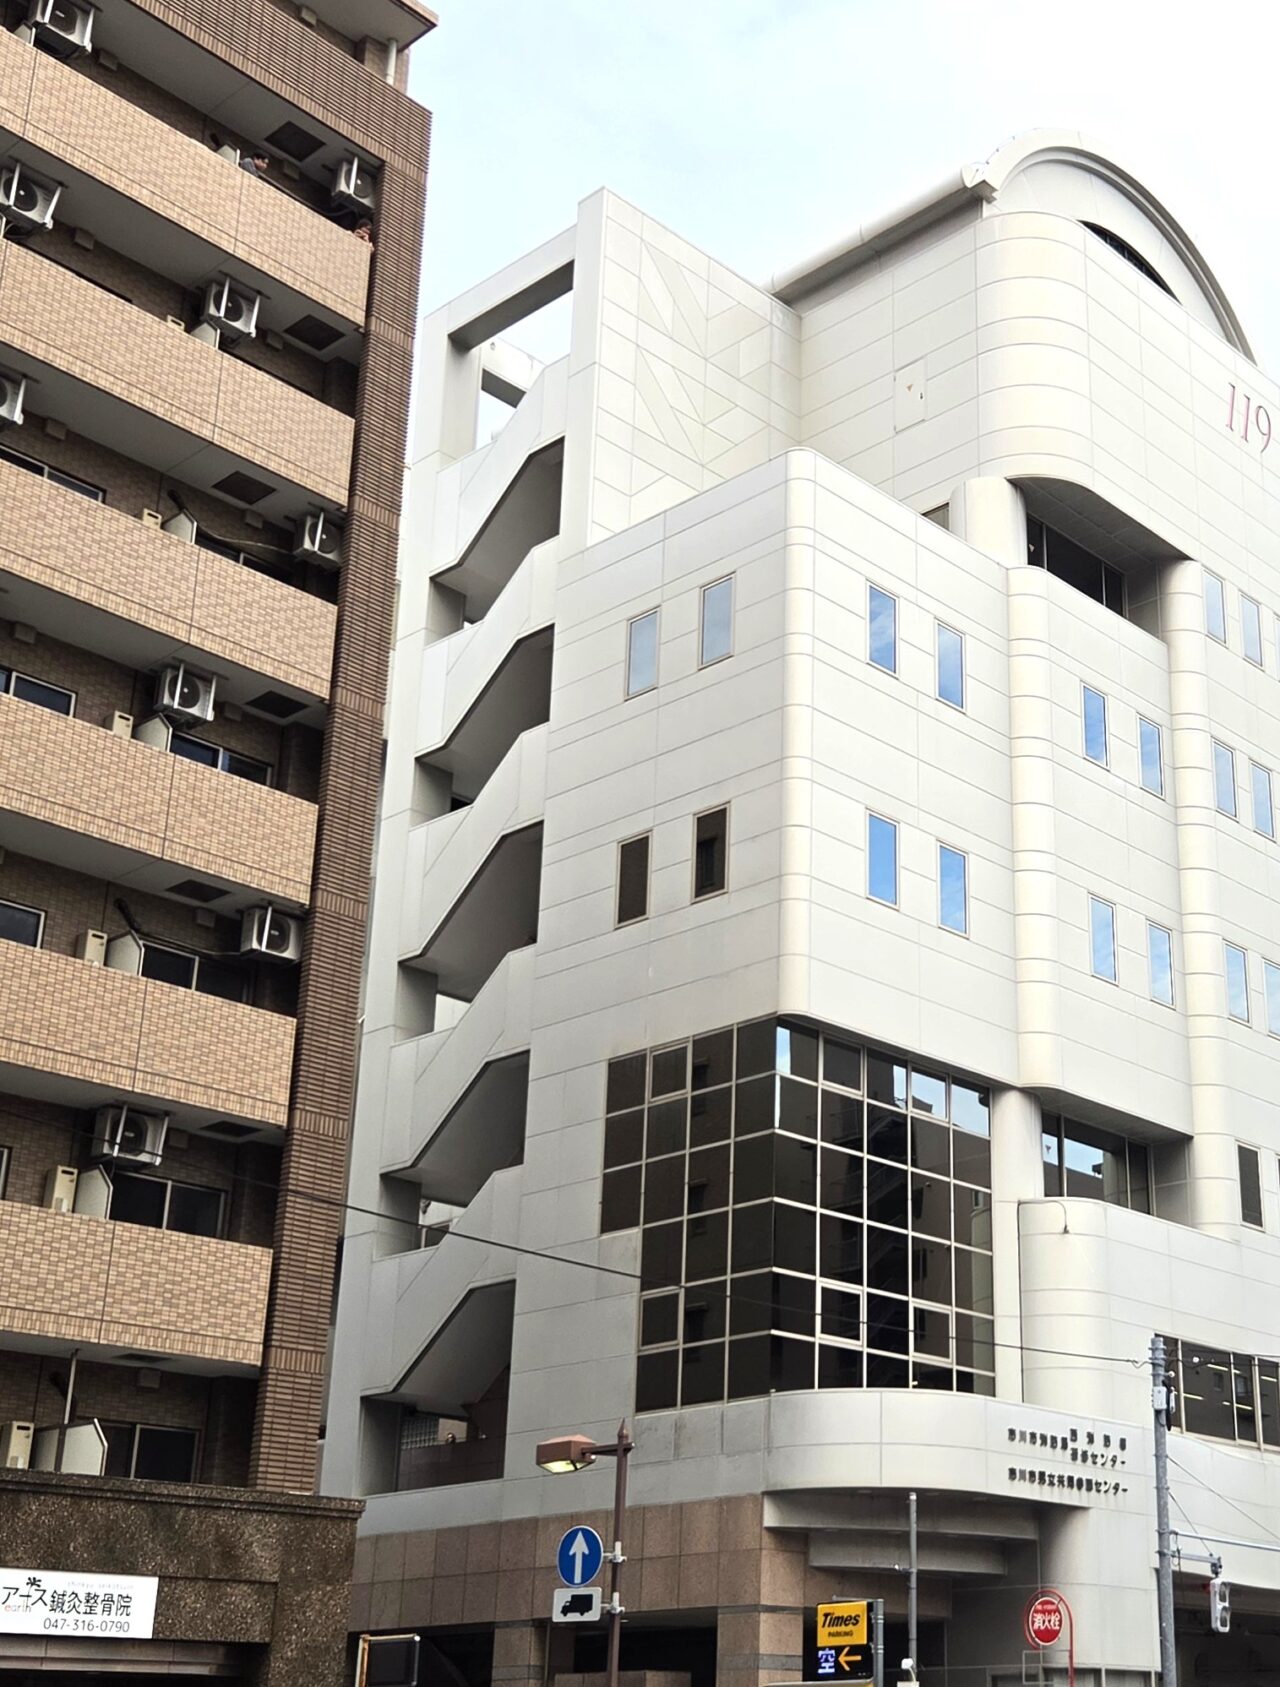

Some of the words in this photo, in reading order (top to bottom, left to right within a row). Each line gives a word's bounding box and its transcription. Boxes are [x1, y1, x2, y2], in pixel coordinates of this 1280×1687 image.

[1225, 381, 1272, 454] 119
[1070, 1447, 1127, 1468] センター
[43, 1617, 130, 1633] 047-316-0790
[822, 1612, 861, 1628] Times
[1033, 1612, 1060, 1630] 消火栓
[818, 1648, 836, 1674] 空
